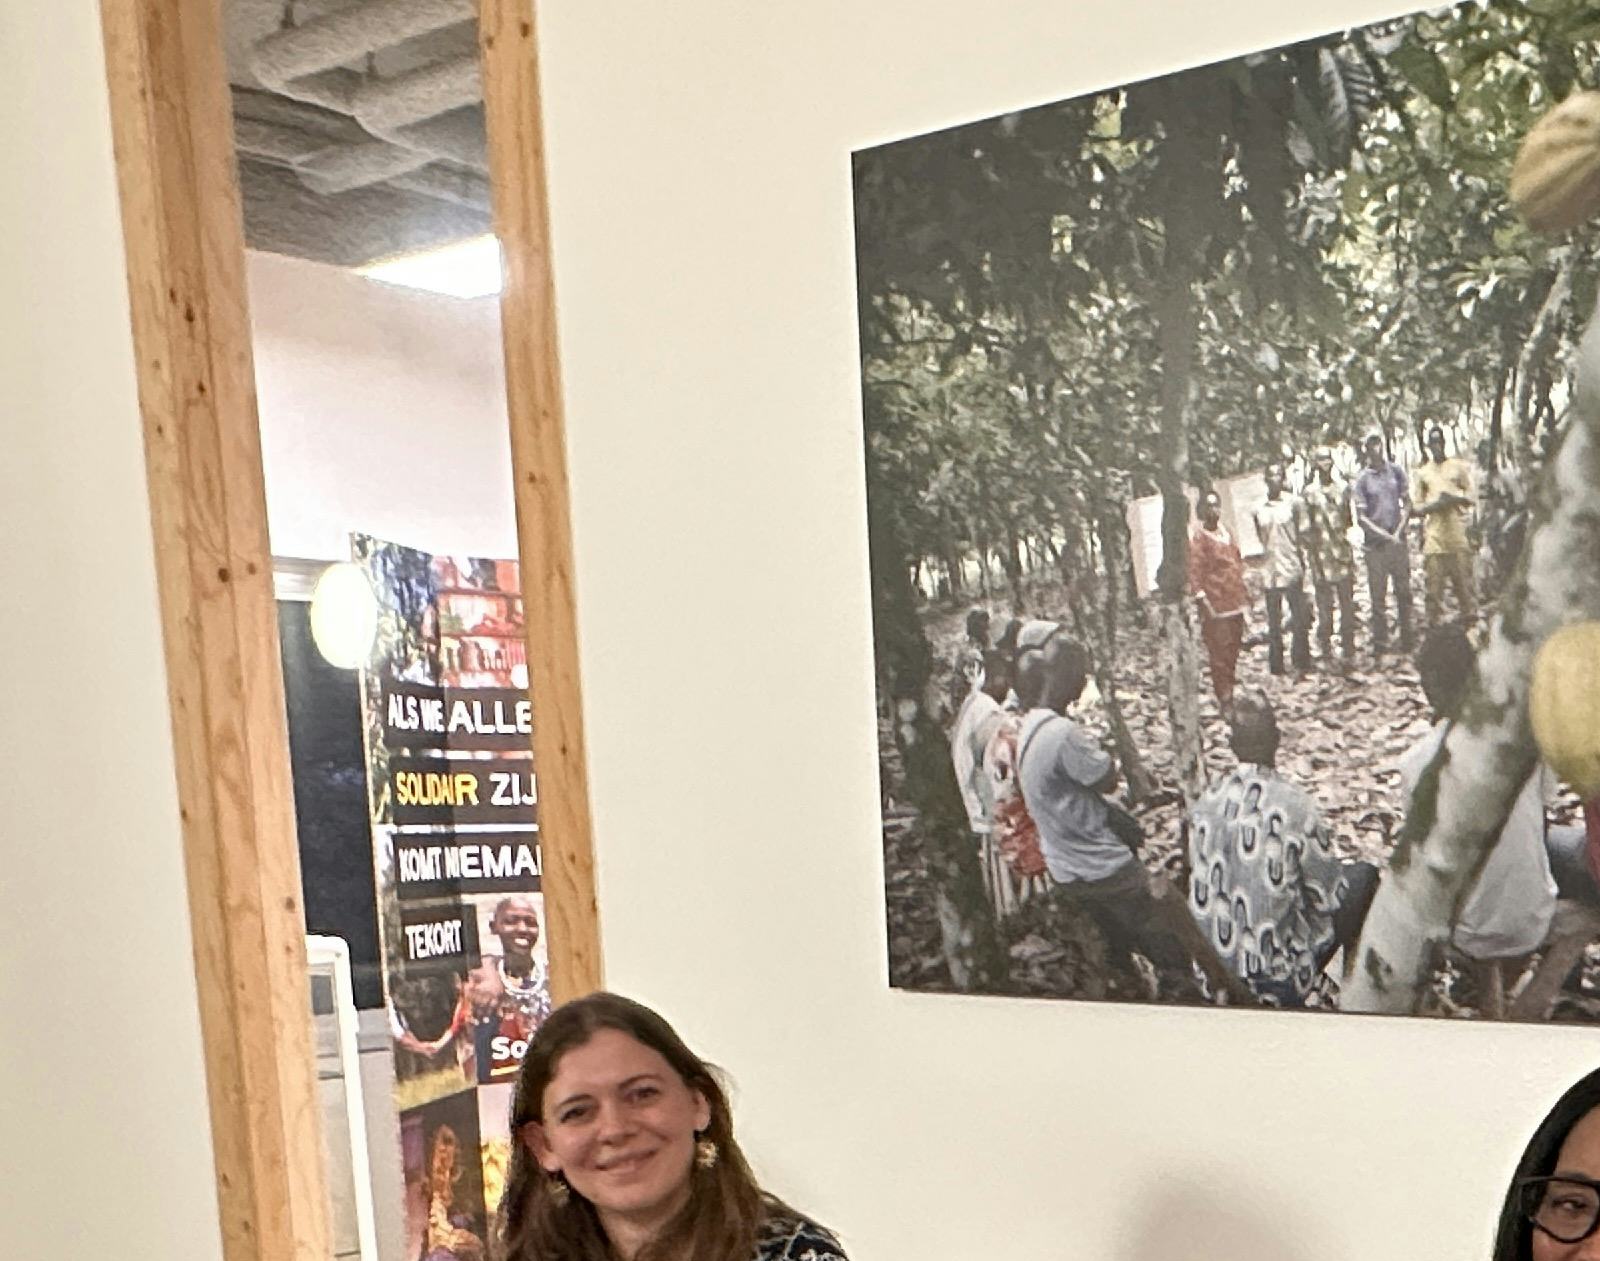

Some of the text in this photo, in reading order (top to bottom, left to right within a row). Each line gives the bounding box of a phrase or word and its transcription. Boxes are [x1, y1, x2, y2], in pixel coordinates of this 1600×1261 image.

[388, 692, 418, 730] ALS
[419, 698, 445, 733] WE
[398, 846, 442, 882] KOMT
[404, 919, 462, 960] TEKORT
